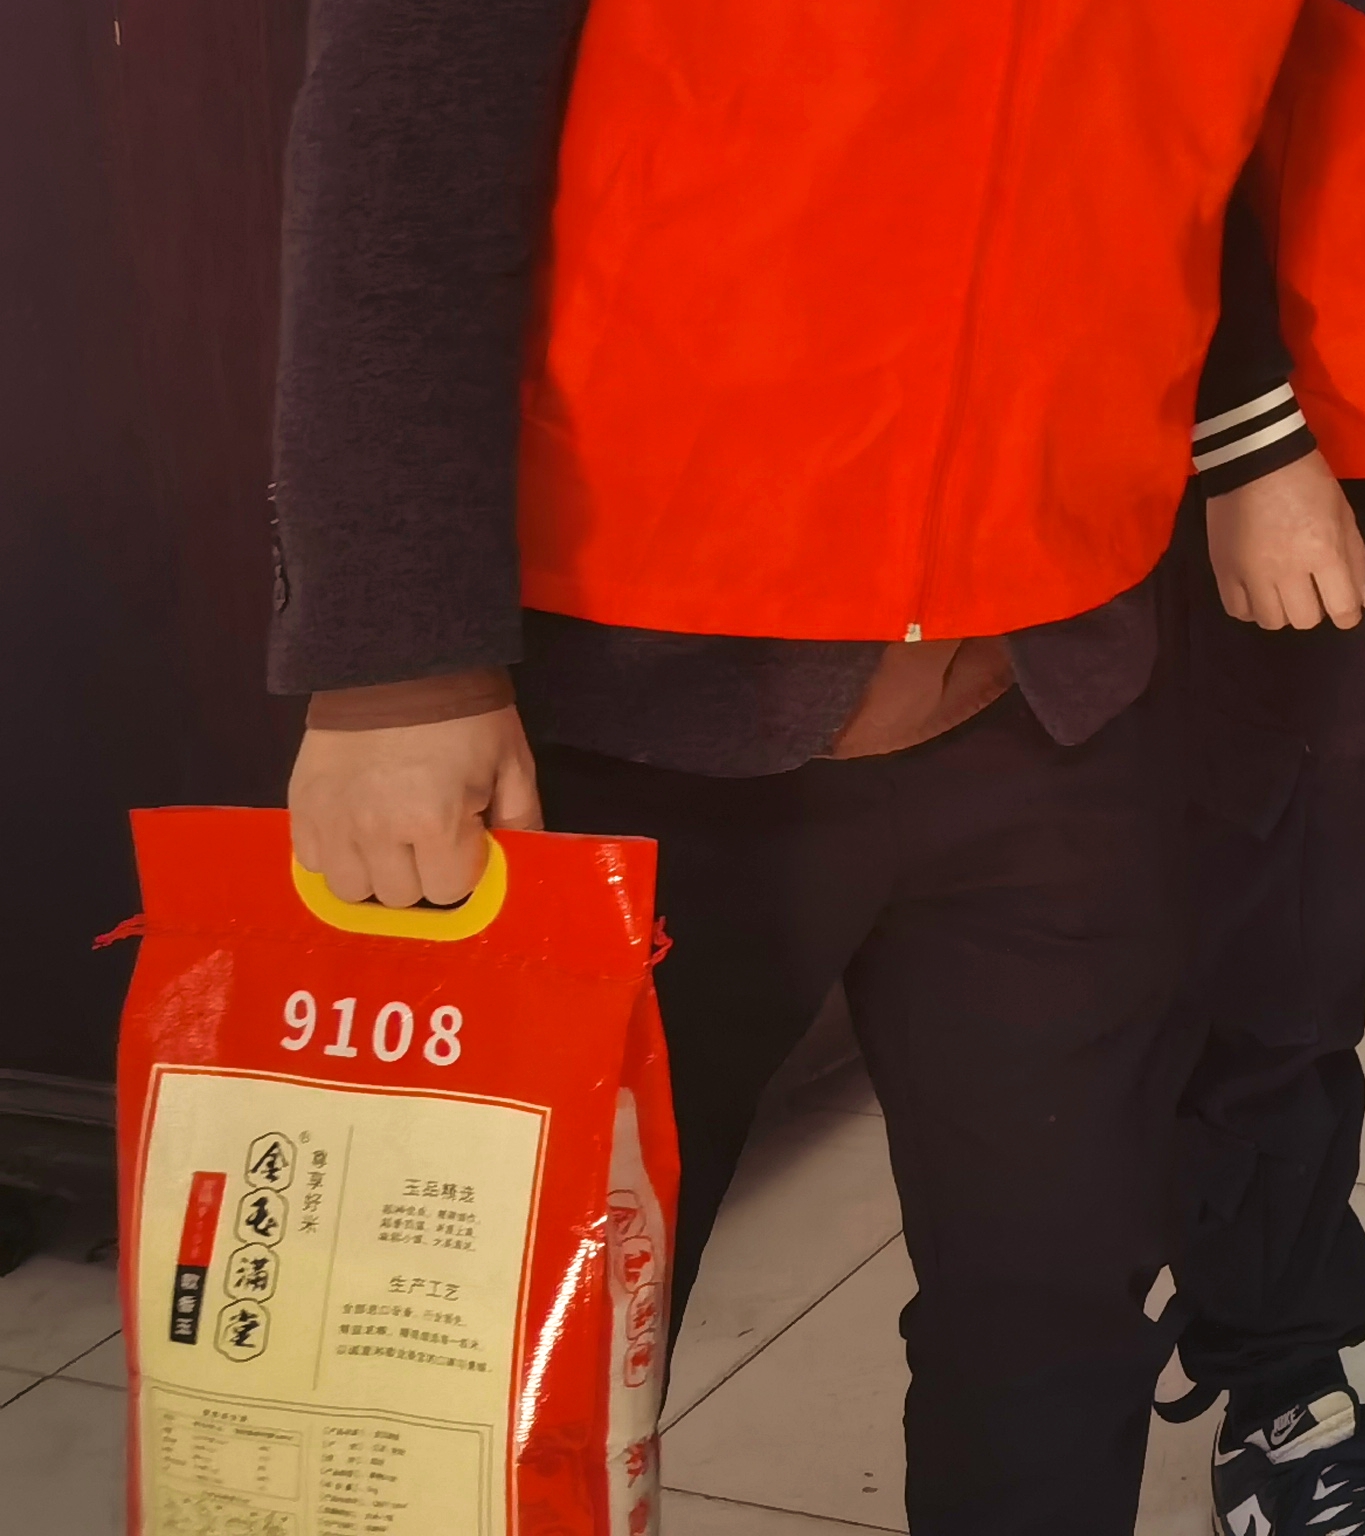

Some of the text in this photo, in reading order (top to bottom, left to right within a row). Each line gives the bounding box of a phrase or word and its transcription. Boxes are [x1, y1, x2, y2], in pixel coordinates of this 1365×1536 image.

[280, 989, 463, 1066] 9108
[388, 1275, 461, 1302] 生产工艺
